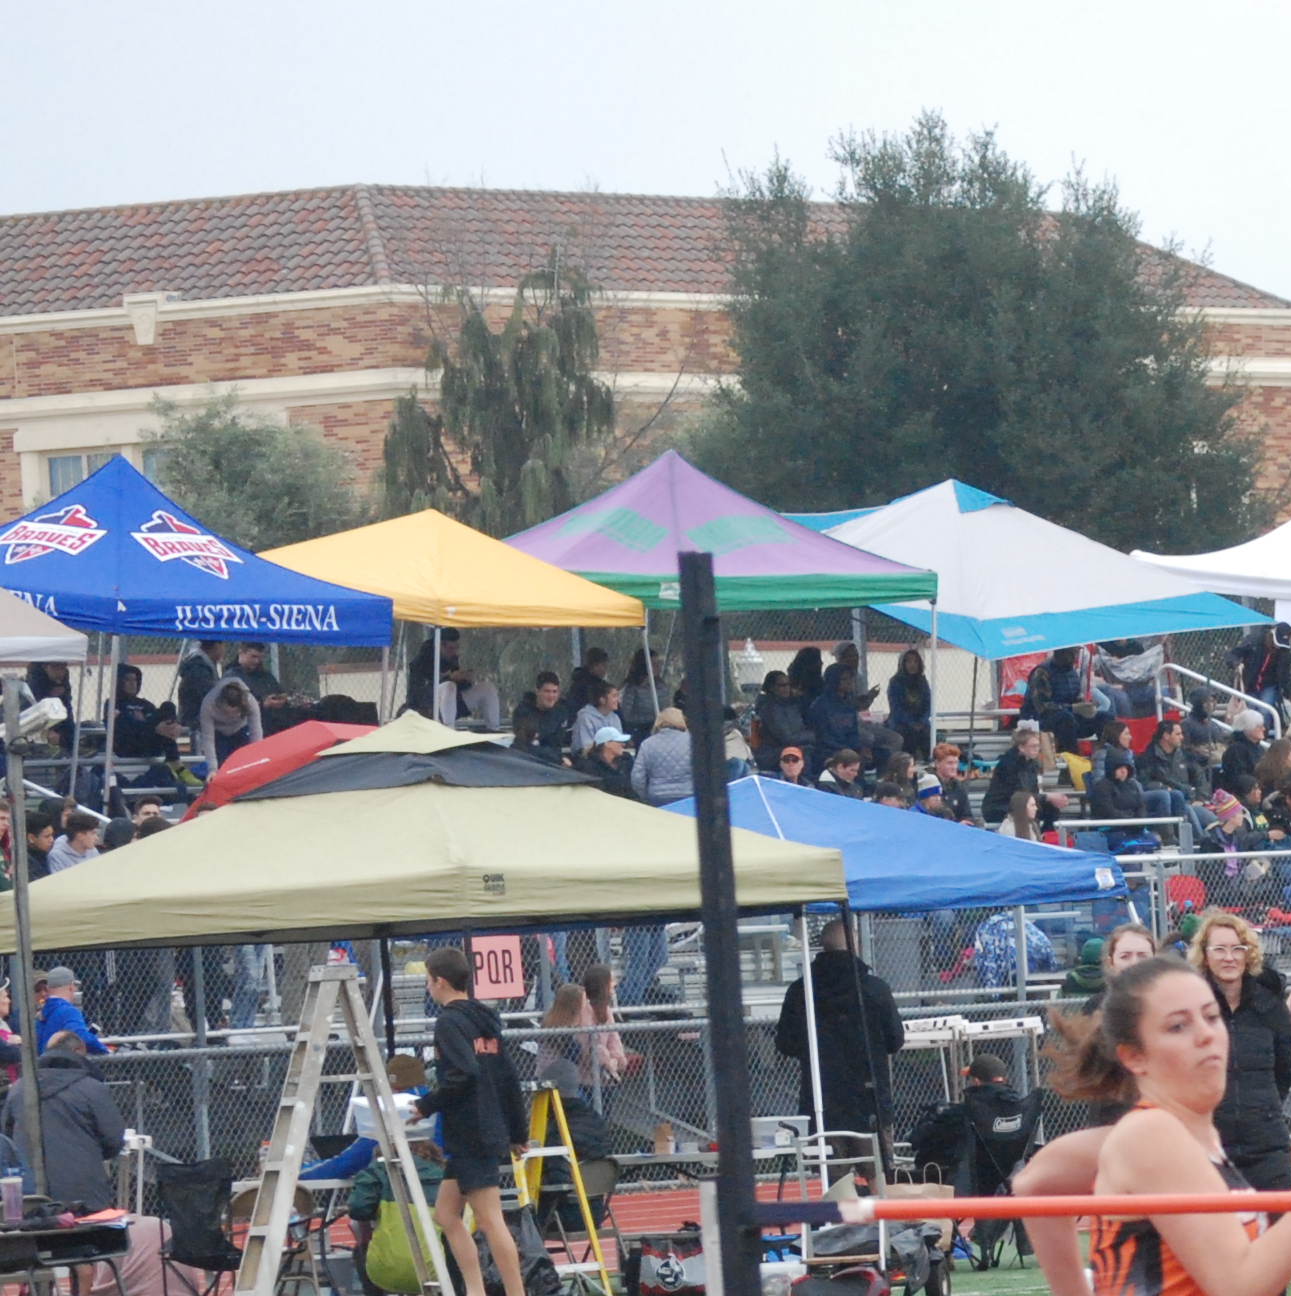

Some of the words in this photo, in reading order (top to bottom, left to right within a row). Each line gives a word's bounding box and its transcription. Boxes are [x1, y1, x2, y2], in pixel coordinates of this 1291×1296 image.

[2, 525, 96, 549] BRAVES
[142, 536, 234, 558] BRAVES
[175, 604, 340, 631] JUSTIN-SIENA
[473, 949, 514, 986] PQR
